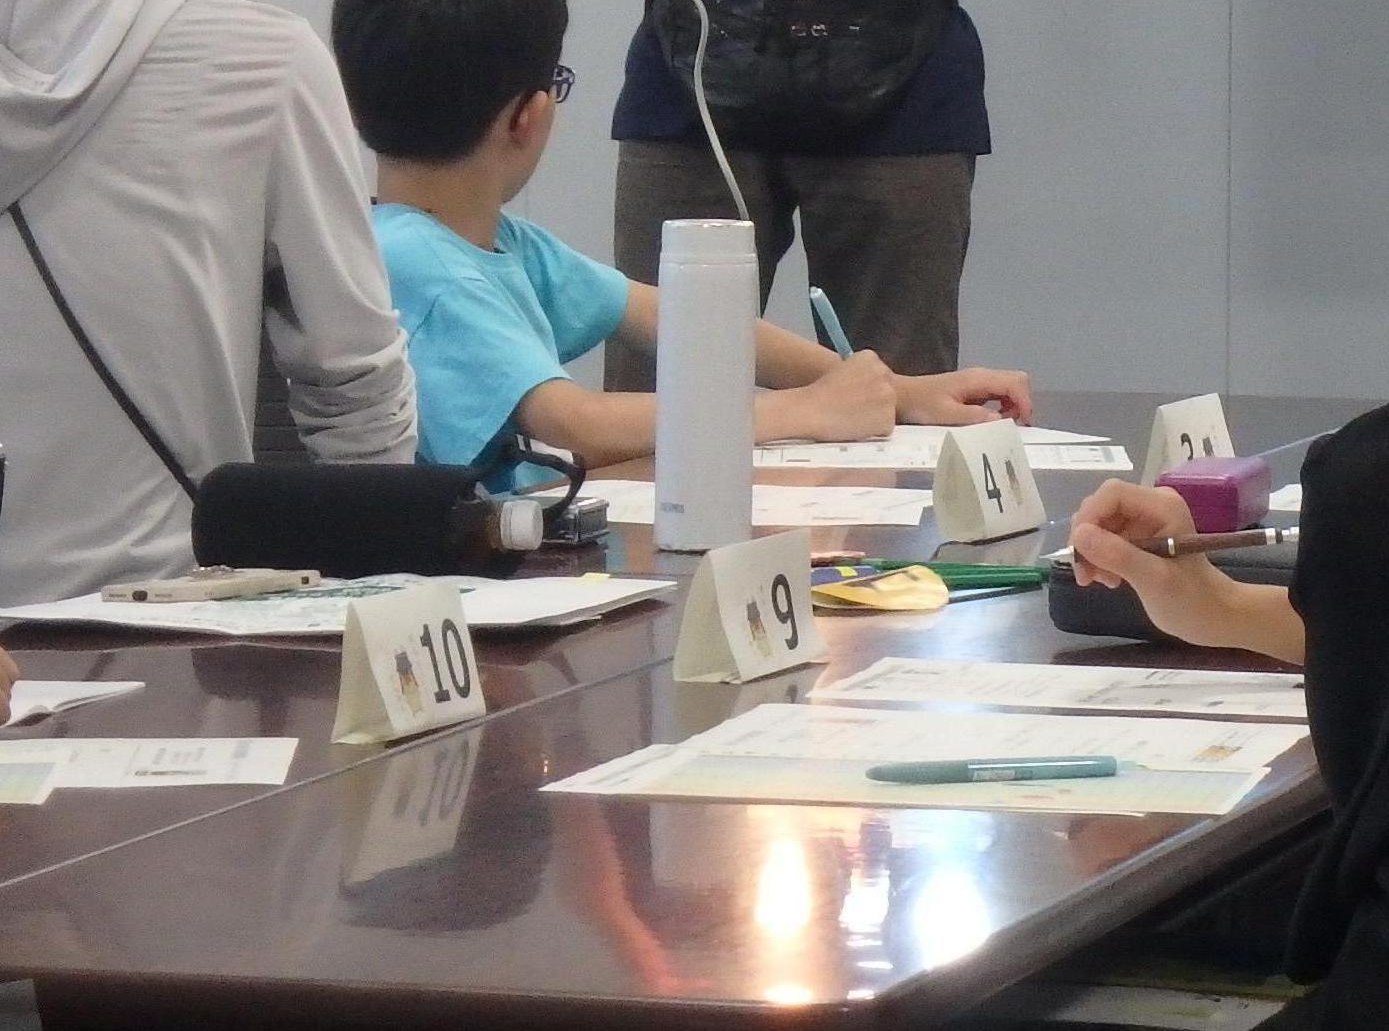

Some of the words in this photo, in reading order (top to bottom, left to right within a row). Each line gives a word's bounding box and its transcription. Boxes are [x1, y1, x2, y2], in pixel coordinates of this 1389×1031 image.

[982, 453, 1004, 514] 4
[771, 573, 799, 651] 9
[419, 618, 471, 704] 10
